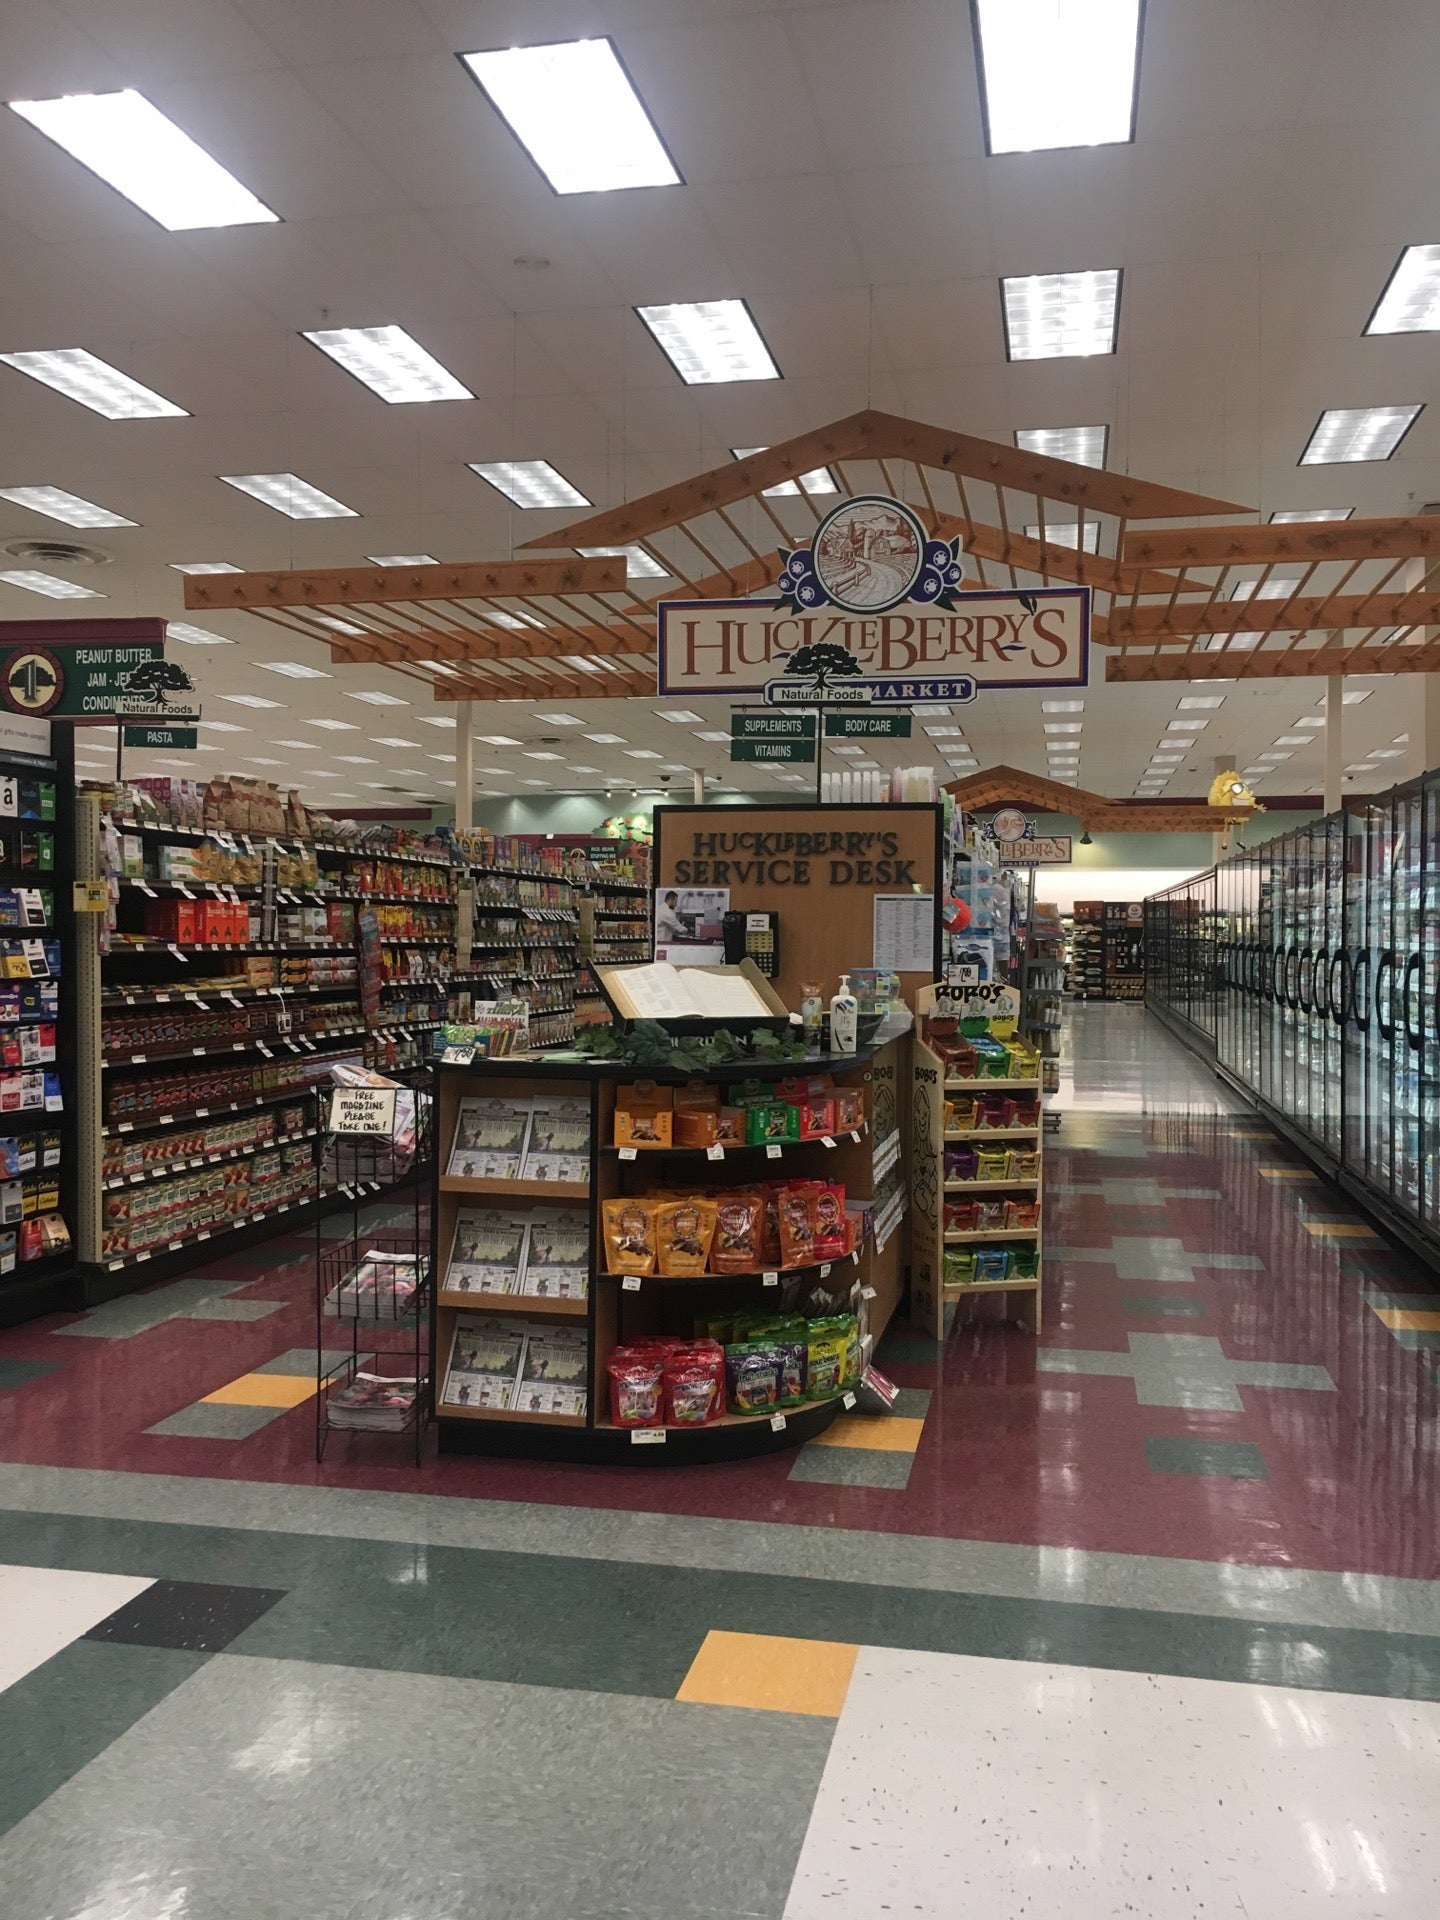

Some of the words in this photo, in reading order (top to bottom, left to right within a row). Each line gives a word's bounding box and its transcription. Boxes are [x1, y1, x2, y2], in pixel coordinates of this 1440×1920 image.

[681, 609, 1068, 676] HUCKLEBERRY'S
[75, 649, 112, 664] PEANUT
[115, 648, 152, 663] BUTTER
[87, 672, 107, 687] JAM
[782, 689, 823, 700] Natural
[827, 688, 864, 700] Foods
[122, 702, 158, 713] Natural
[161, 704, 193, 714] Foods
[745, 719, 801, 733] SUPPLEMENTS
[845, 719, 866, 733] BODY
[868, 719, 891, 733] CARE
[147, 731, 173, 744] PASTA
[754, 744, 791, 758] VITAMINS
[693, 832, 898, 857] HUCKLEBERRY'S
[674, 860, 811, 886] SERVICE
[829, 860, 918, 886] DESK
[914, 1066, 938, 1084] BOBO'S
[354, 1091, 375, 1100] FREE
[340, 1101, 385, 1111] MAGAZINE
[344, 1111, 376, 1120] PLEASE
[338, 1121, 360, 1131] TAKE
